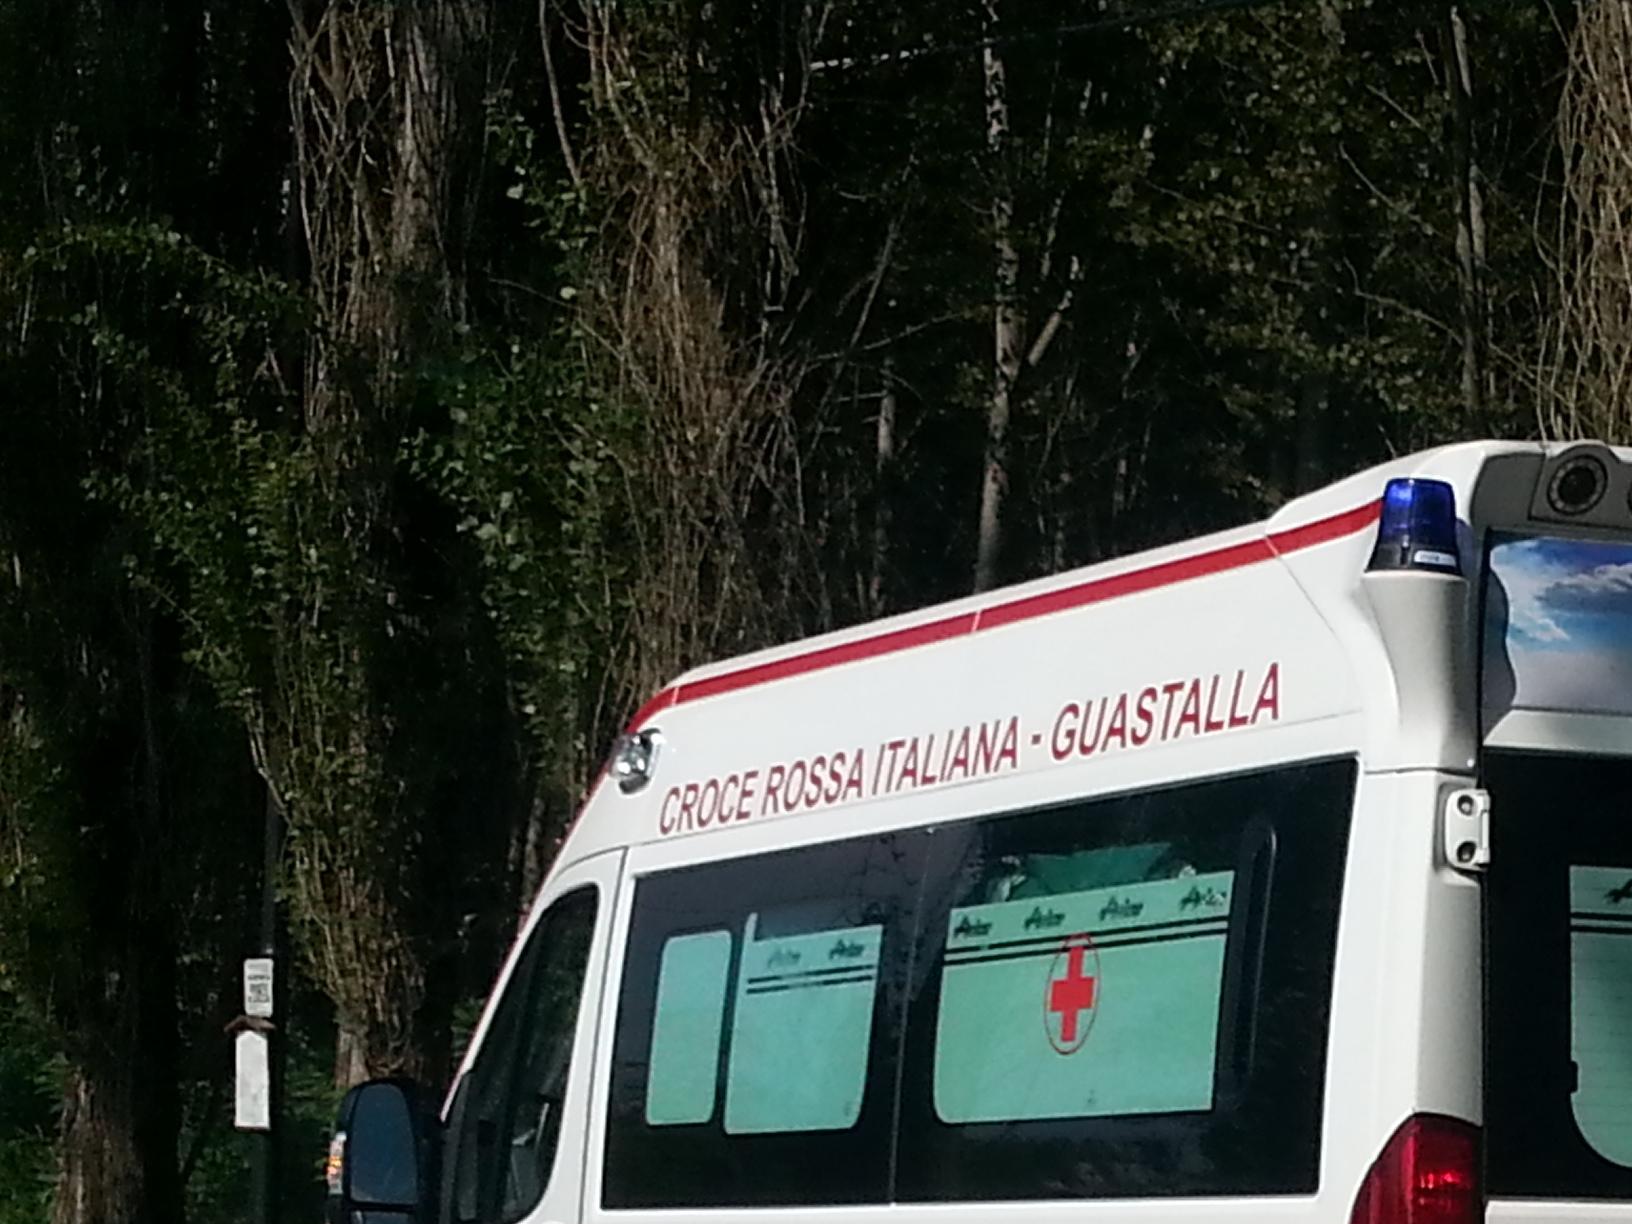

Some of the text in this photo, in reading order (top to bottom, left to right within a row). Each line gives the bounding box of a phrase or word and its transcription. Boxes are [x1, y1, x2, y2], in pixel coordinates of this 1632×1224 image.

[659, 662, 1279, 835] CROCE ROSSA ITALIANA - GUASTALLA
